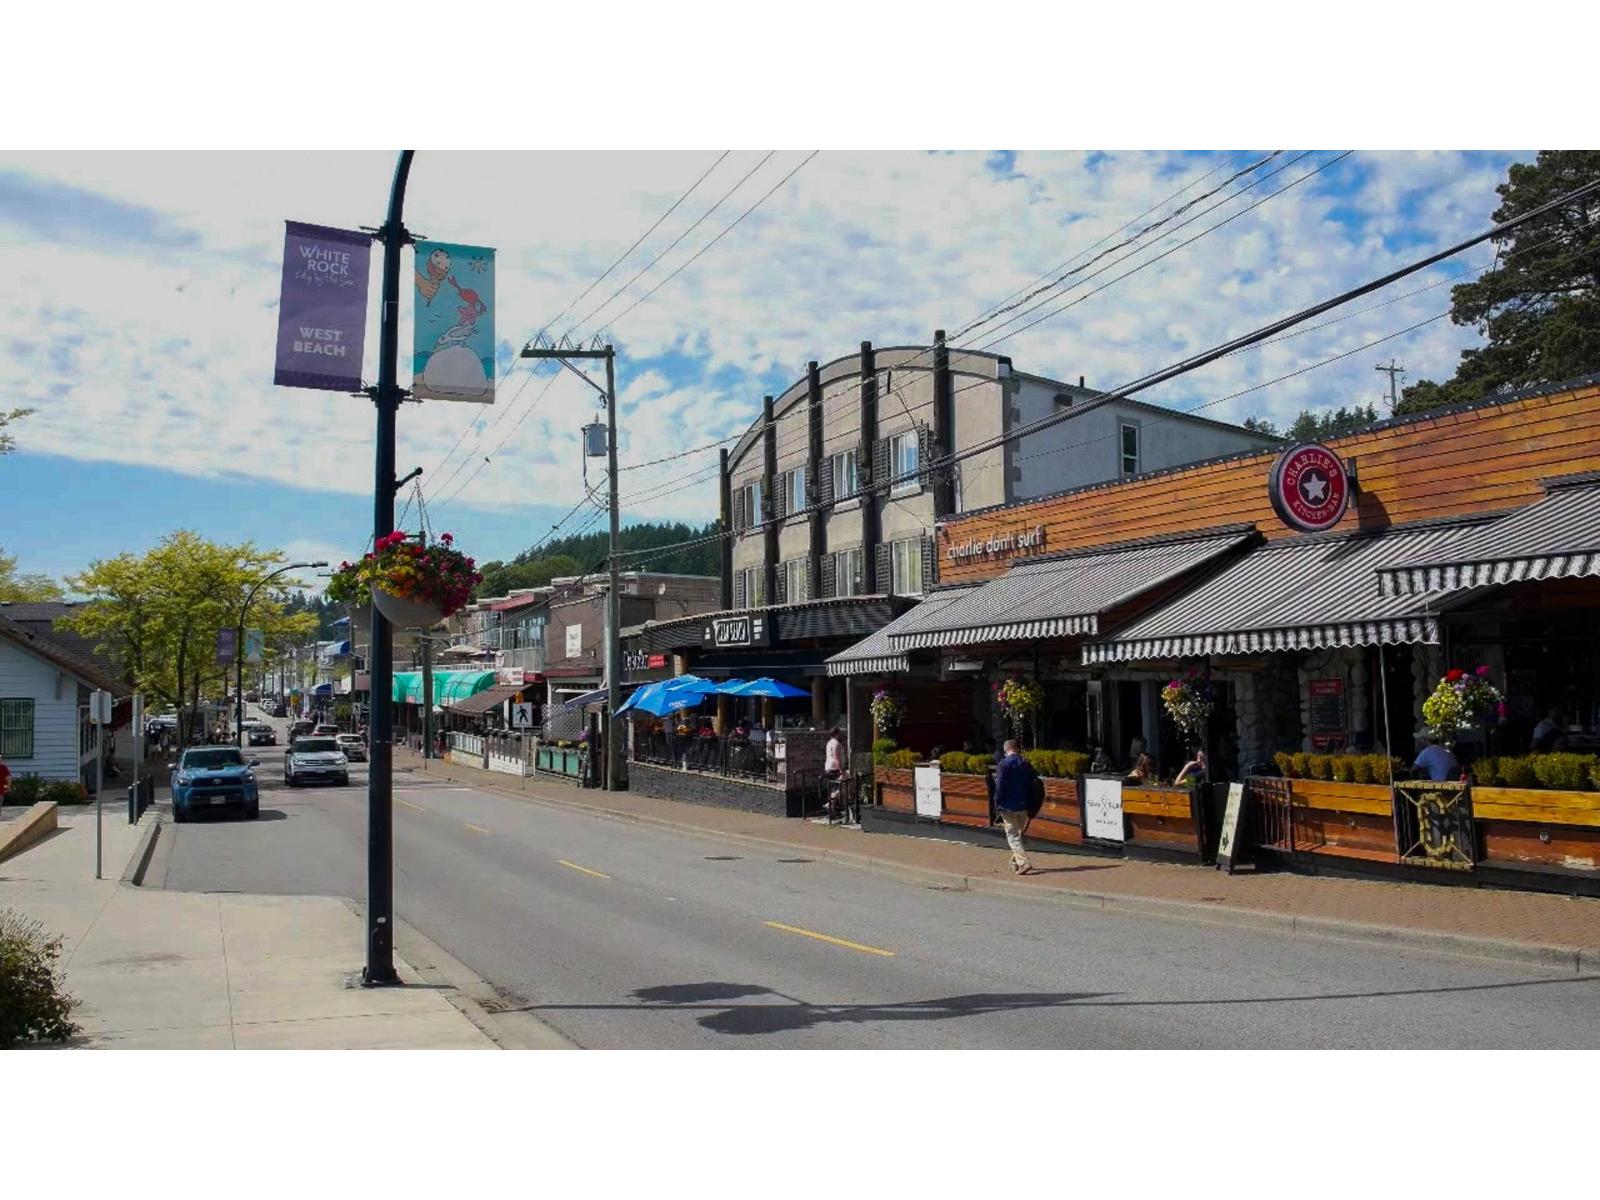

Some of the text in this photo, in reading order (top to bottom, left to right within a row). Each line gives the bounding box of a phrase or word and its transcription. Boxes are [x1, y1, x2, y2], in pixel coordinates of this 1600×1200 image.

[299, 245, 350, 264] WHITE
[307, 259, 349, 275] ROCK
[299, 326, 343, 341] WEST
[293, 341, 346, 357] BEACH
[1286, 453, 1338, 486] CHARLIE'S
[947, 538, 982, 559] charlie
[1017, 524, 1042, 548] surf
